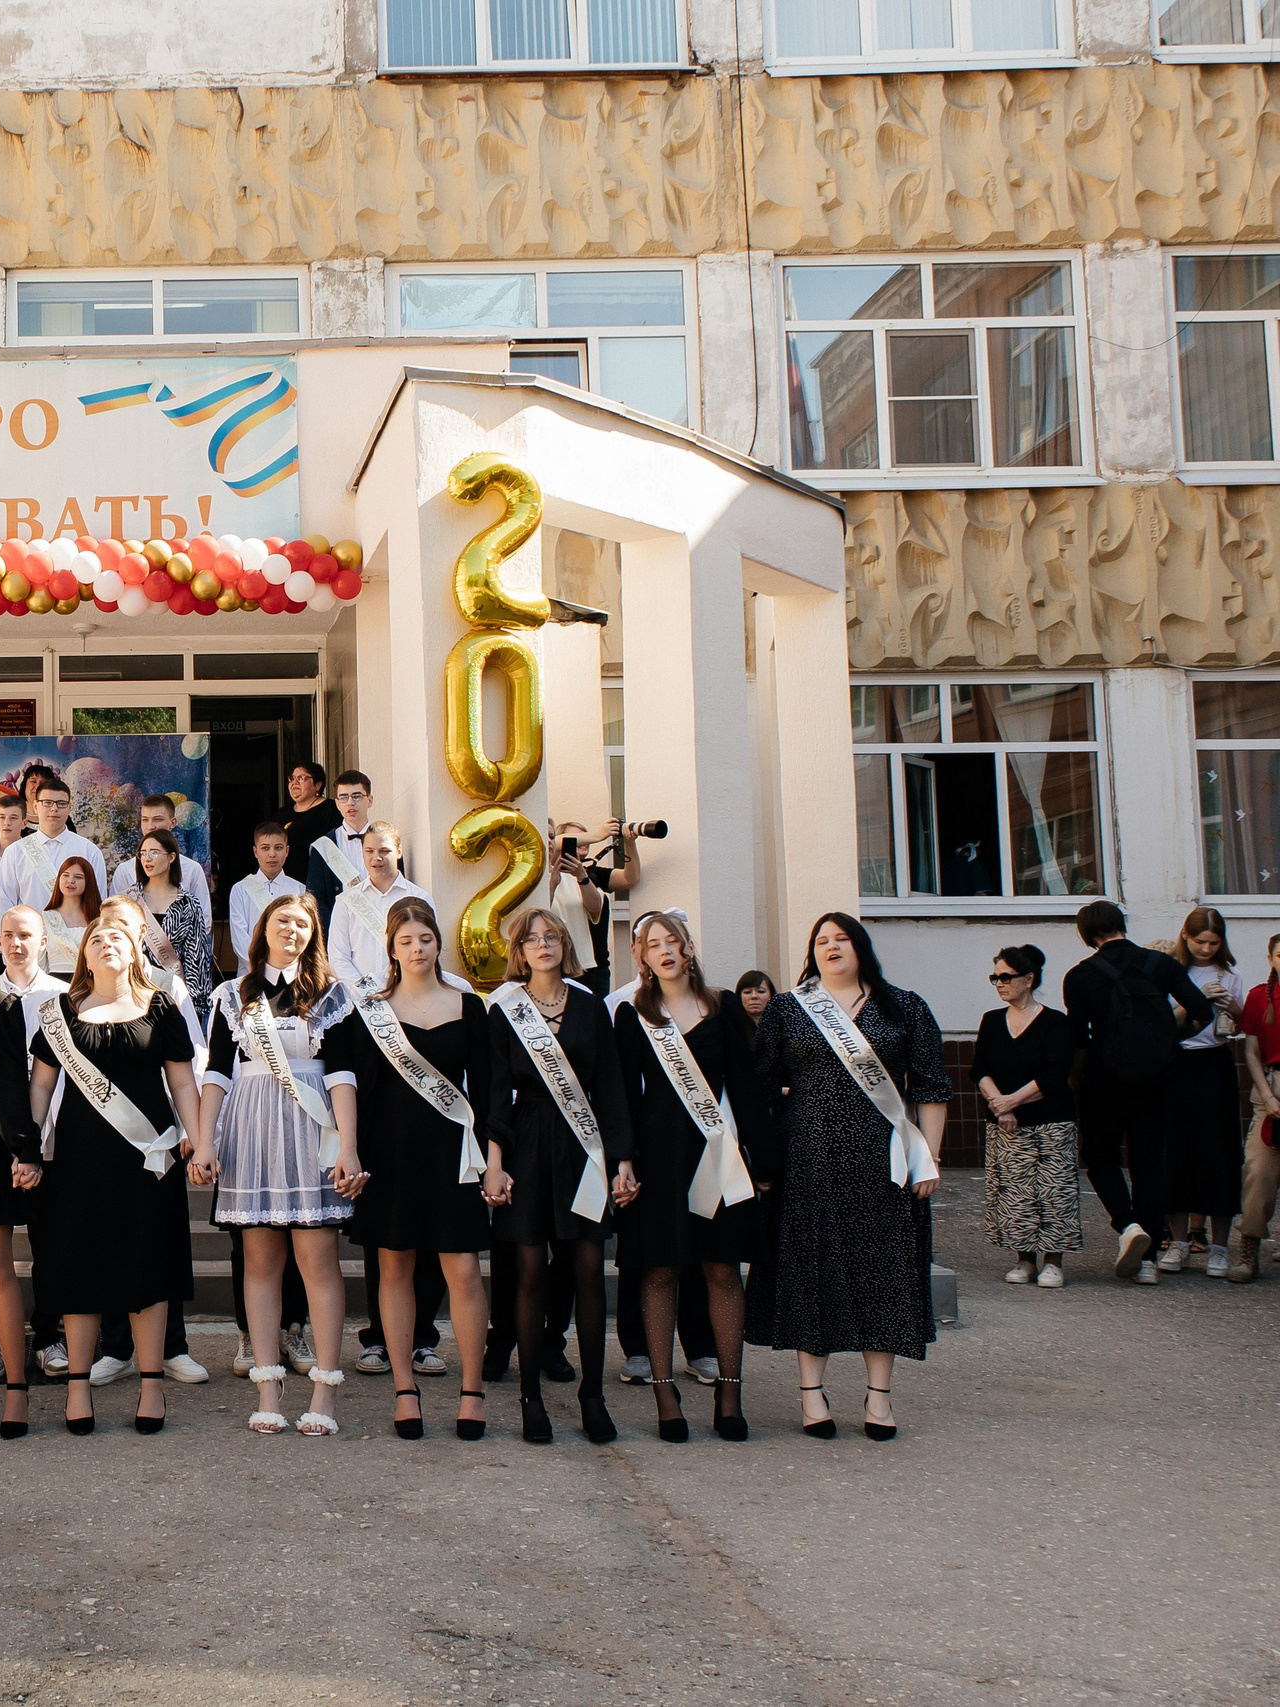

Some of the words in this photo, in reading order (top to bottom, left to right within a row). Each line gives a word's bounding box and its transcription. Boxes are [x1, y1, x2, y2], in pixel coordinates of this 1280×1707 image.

[212, 721, 244, 732] ВХОД
[367, 1013, 430, 1090] Выпускник
[429, 1079, 460, 1107] 2025
[803, 991, 862, 1064] Выпускник
[856, 1059, 887, 1086] 2025
[87, 1077, 118, 1104] 2025
[520, 1025, 577, 1111] Выпускник
[572, 1107, 599, 1136] 2025
[694, 1098, 724, 1128] 2025
